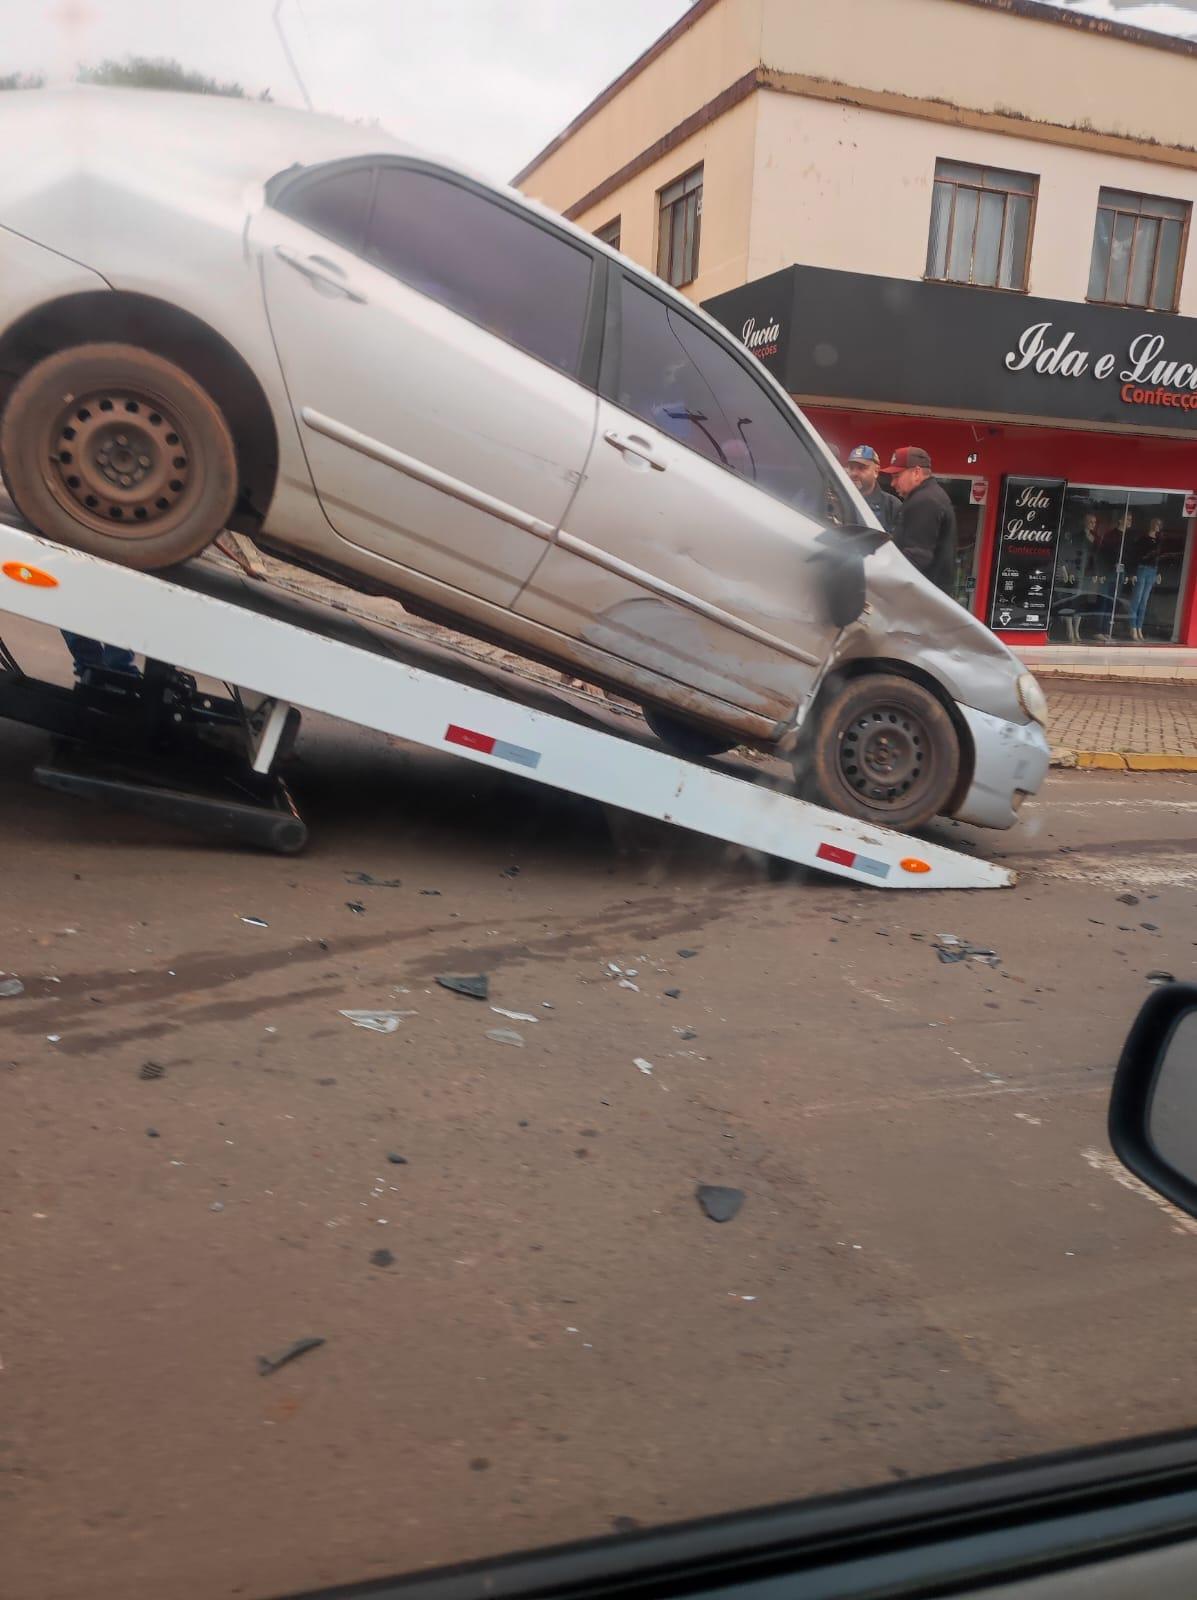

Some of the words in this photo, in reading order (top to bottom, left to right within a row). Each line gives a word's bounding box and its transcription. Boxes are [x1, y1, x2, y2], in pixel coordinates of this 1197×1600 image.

[742, 317, 780, 348] Lucia
[1005, 322, 1089, 377] Ida
[1094, 353, 1116, 380] e
[1015, 486, 1050, 508] Ida
[1026, 510, 1036, 522] e
[1004, 519, 1053, 542] Lucia
